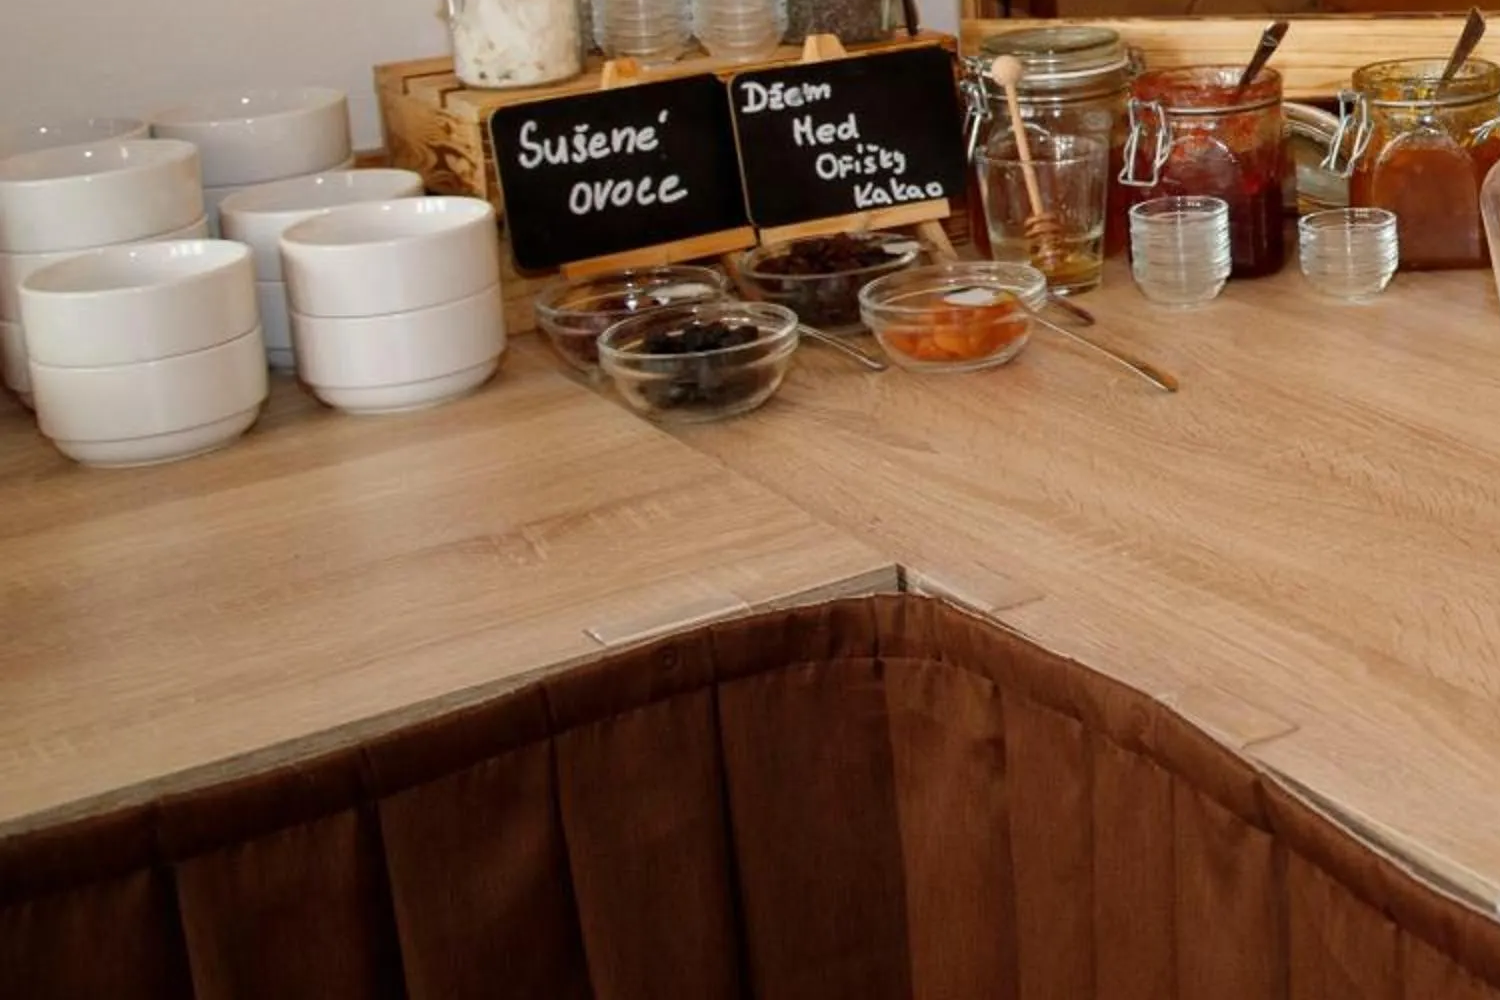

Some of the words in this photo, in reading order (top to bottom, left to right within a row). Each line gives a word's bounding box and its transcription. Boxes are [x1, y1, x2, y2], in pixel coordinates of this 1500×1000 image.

[740, 81, 832, 114] Džem
[518, 109, 668, 169] Sušené
[793, 112, 860, 147] Med
[853, 176, 944, 208] Kakao
